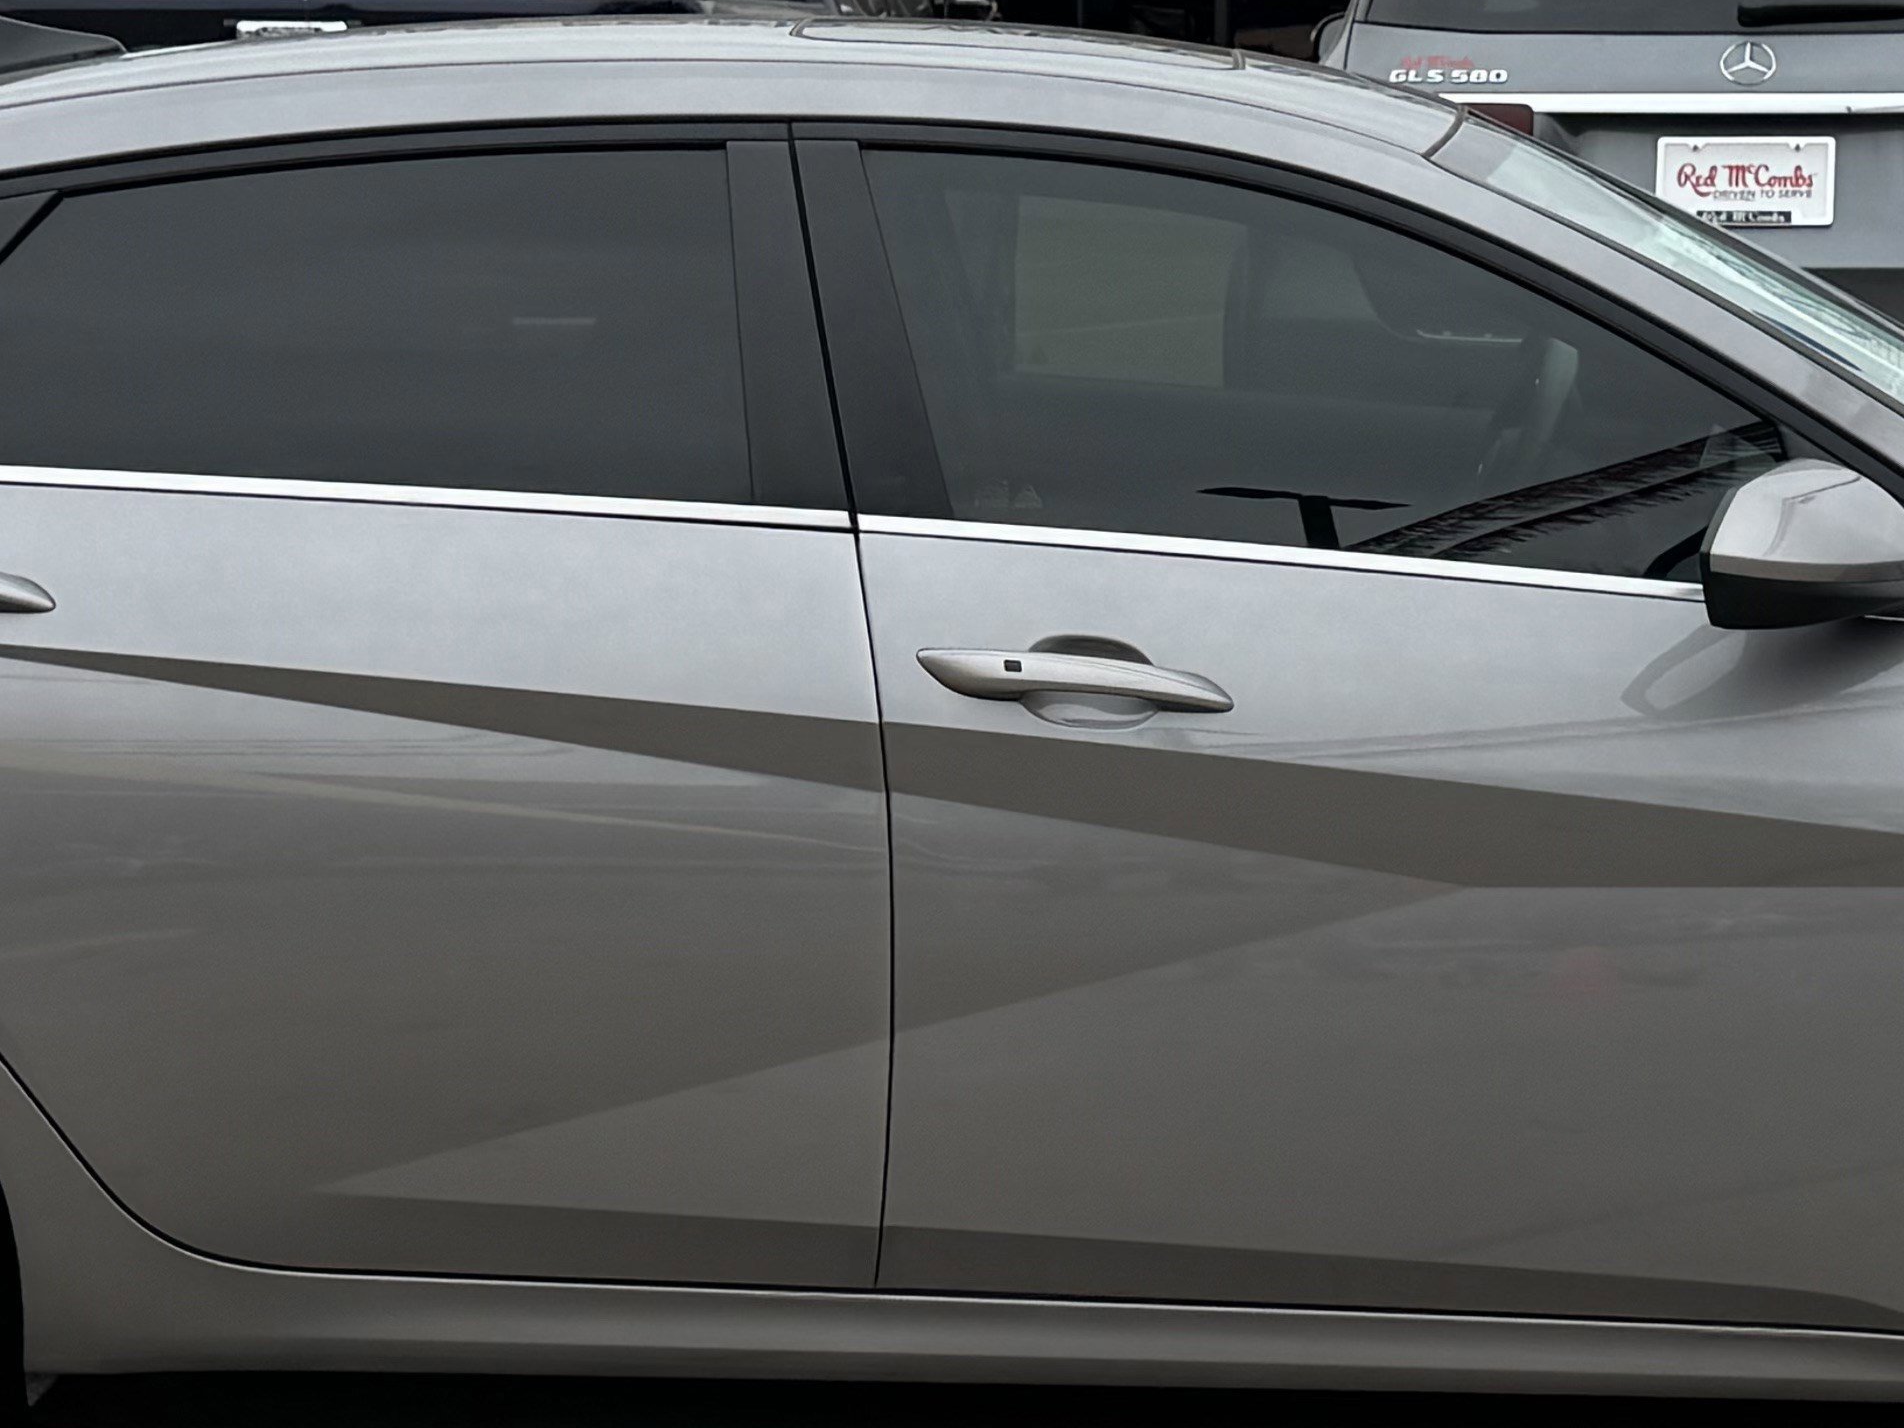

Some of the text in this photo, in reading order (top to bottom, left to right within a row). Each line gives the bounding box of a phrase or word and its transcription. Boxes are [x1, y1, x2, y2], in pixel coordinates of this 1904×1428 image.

[1389, 68, 1445, 84] GLS
[1676, 162, 1814, 198] Red McCombs
[1760, 188, 1776, 199] TO
[1778, 188, 1813, 200] SERVE
